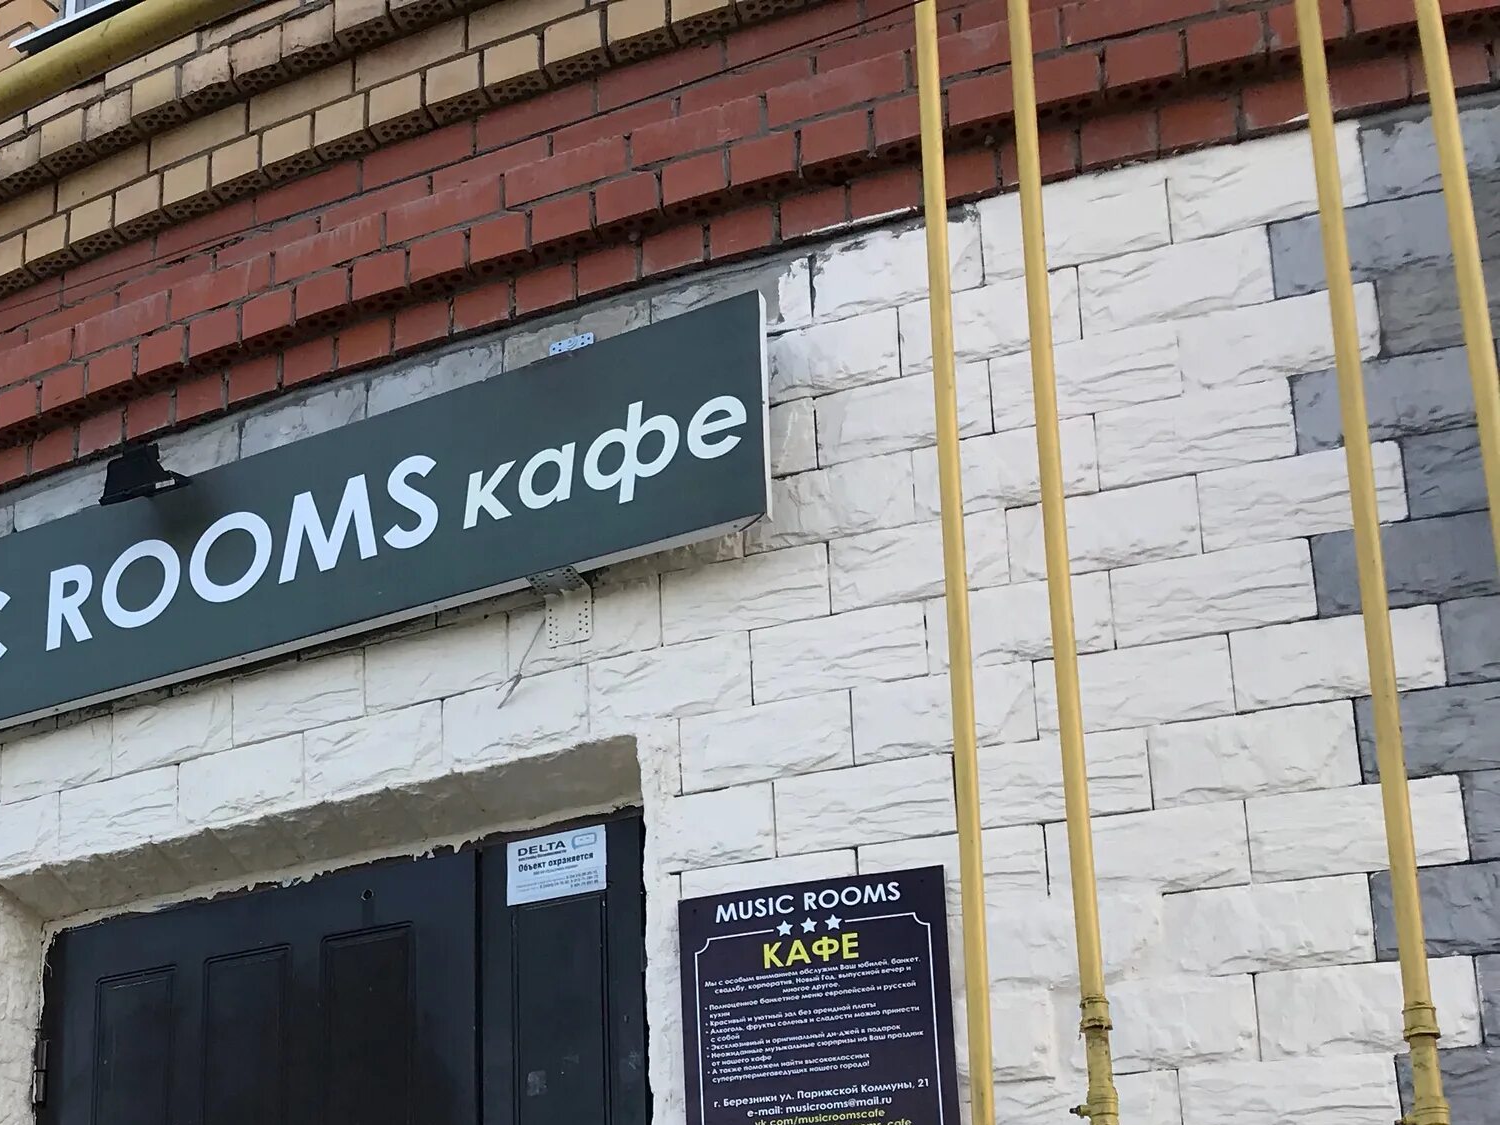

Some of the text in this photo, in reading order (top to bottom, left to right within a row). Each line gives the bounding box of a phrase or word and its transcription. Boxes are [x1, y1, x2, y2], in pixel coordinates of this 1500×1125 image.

[45, 454, 439, 651] ROOMS
[463, 394, 749, 531] кафе
[518, 840, 566, 857] DELTA
[518, 861, 546, 872] Объект
[548, 852, 594, 866] охраняется
[715, 882, 901, 923] MUSIC ROOMS
[763, 932, 860, 969] КАФЕ
[724, 976, 754, 985] особым
[756, 971, 798, 980] вниманием
[799, 966, 838, 976] обслужим
[796, 974, 819, 984] Новый
[838, 968, 880, 979] выпускной
[709, 1000, 758, 1011] Полноценное
[760, 995, 800, 1004] банкетное
[825, 985, 875, 996] европейской
[883, 980, 916, 991] русской
[710, 1016, 746, 1027] Красивый
[754, 1012, 783, 1022] уютный
[813, 1004, 851, 1014] арендной
[746, 1022, 776, 1031] фрукты
[778, 1018, 808, 1026] соленья
[816, 1014, 852, 1022] сладости
[882, 1006, 920, 1015] принести
[711, 1038, 764, 1050] Эксклюзивный
[772, 1032, 825, 1044] оригинальный
[867, 1024, 901, 1033] подарок
[711, 1048, 763, 1058] Неожиданные
[765, 1042, 815, 1053] музыкальные
[817, 1039, 856, 1047] сюрпризы
[887, 1031, 924, 1040] праздник
[717, 1033, 740, 1042] собой
[744, 1063, 779, 1071] поможем
[805, 1053, 870, 1064] высококлассных
[840, 1061, 870, 1069] города!
[723, 1095, 777, 1107] Березники
[779, 1094, 794, 1102] ул.
[797, 1085, 858, 1100] Парижской
[860, 1081, 915, 1092] Коммуны,
[918, 1078, 929, 1087] 21
[747, 1096, 892, 1117] e-mail: musicrooms@mail.ru
